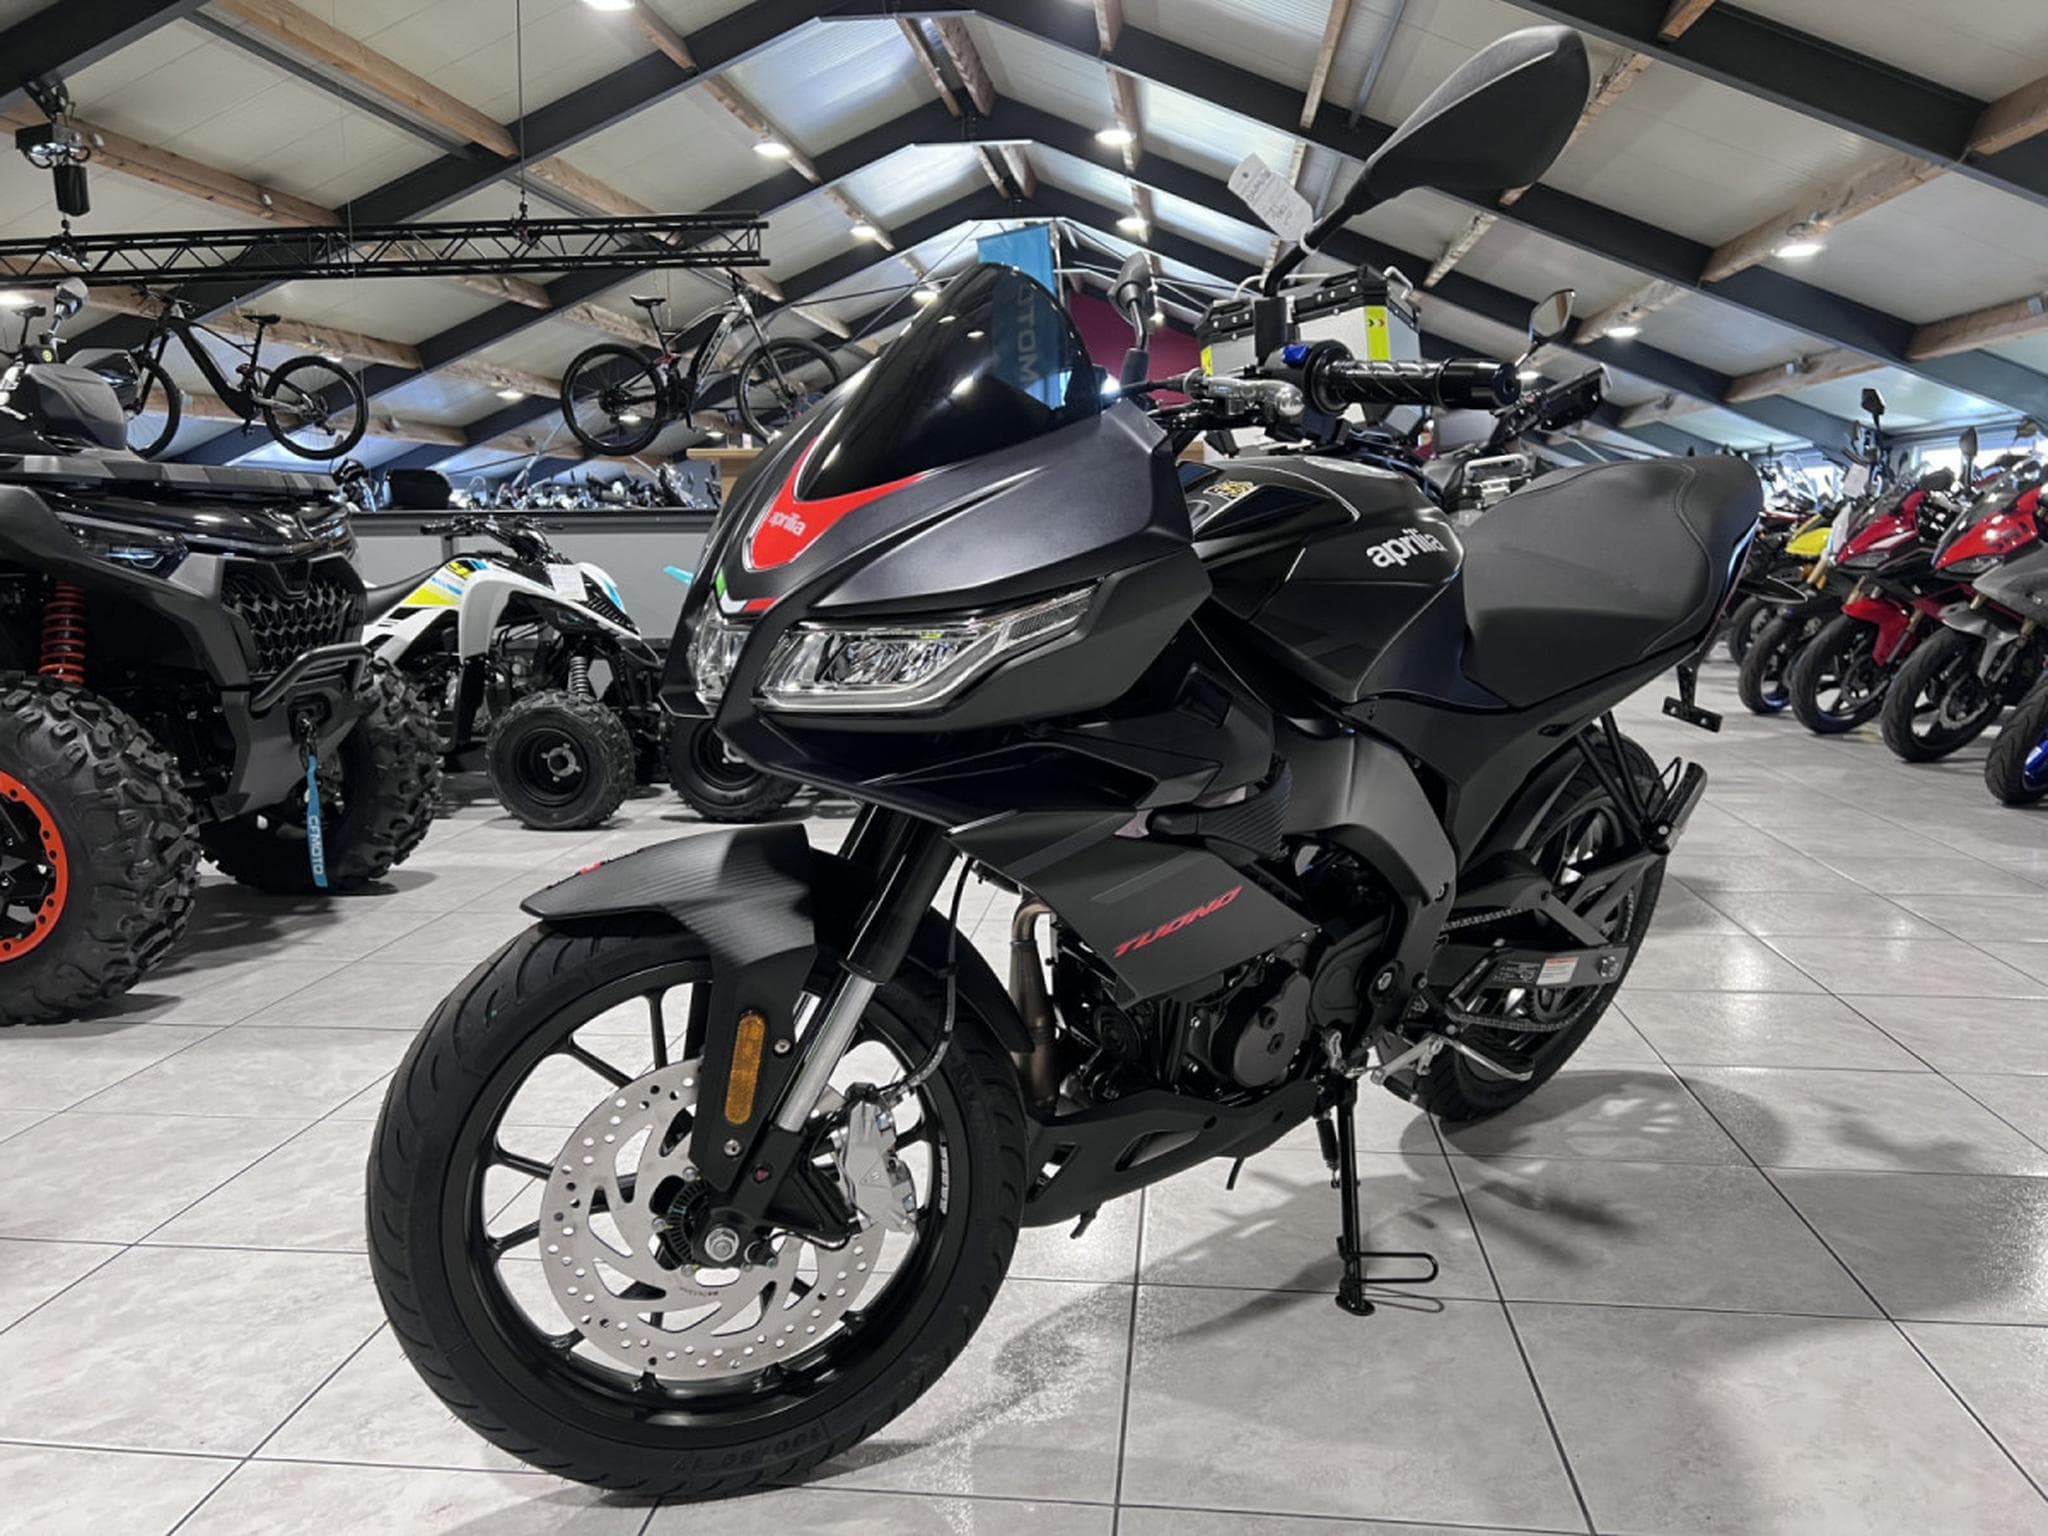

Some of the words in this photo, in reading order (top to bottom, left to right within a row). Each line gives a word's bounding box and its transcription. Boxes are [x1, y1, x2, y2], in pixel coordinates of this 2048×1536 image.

[1366, 528, 1448, 568] aprilia
[308, 815, 324, 875] CFMOTO
[1113, 885, 1243, 958] TUONO
